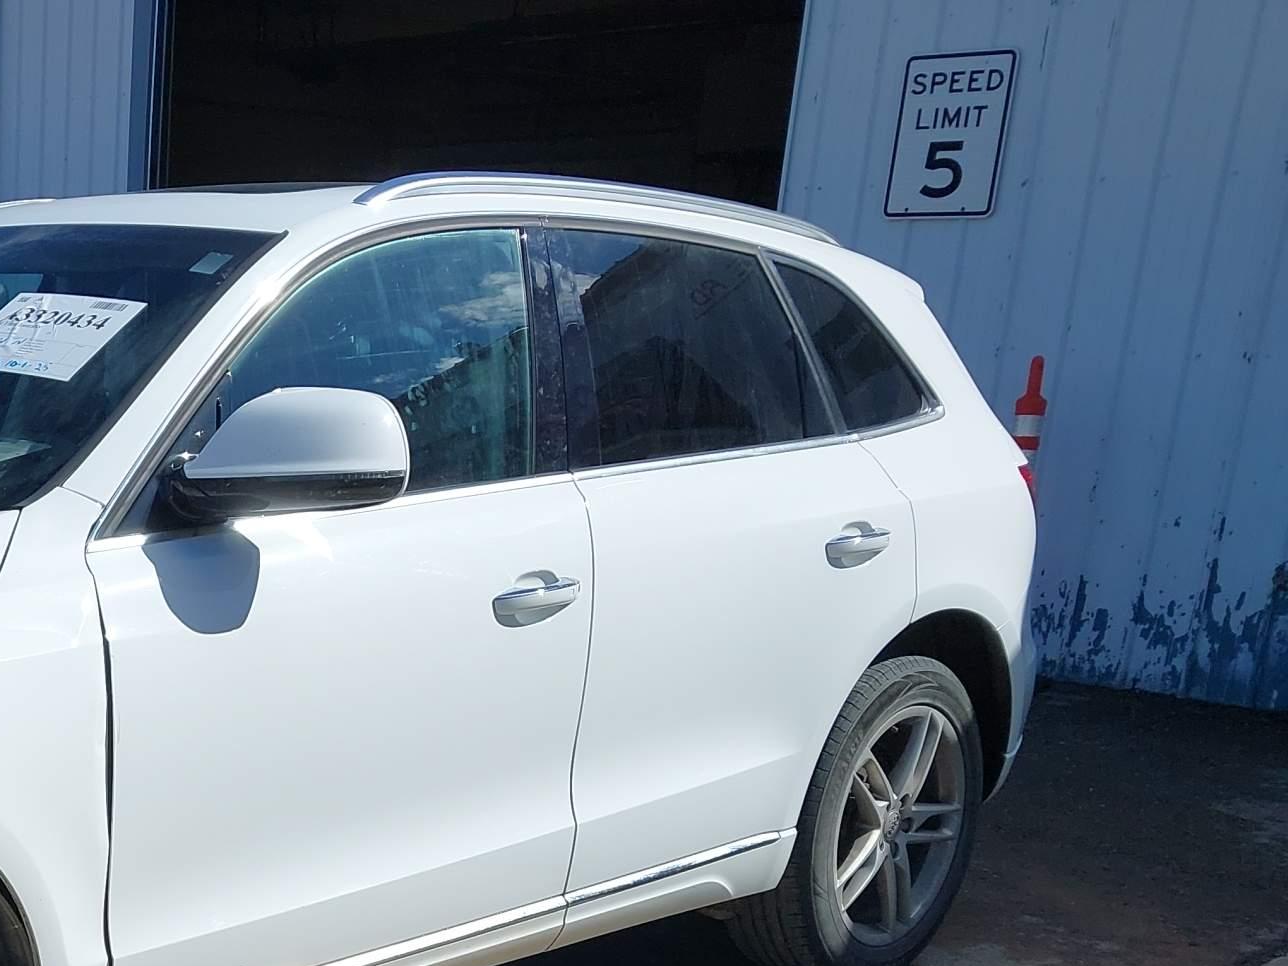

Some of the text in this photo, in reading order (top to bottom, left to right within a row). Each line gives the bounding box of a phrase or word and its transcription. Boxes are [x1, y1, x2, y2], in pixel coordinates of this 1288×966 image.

[911, 69, 1004, 95] SPEED
[915, 105, 989, 130] LIMIT
[919, 140, 965, 199] 5
